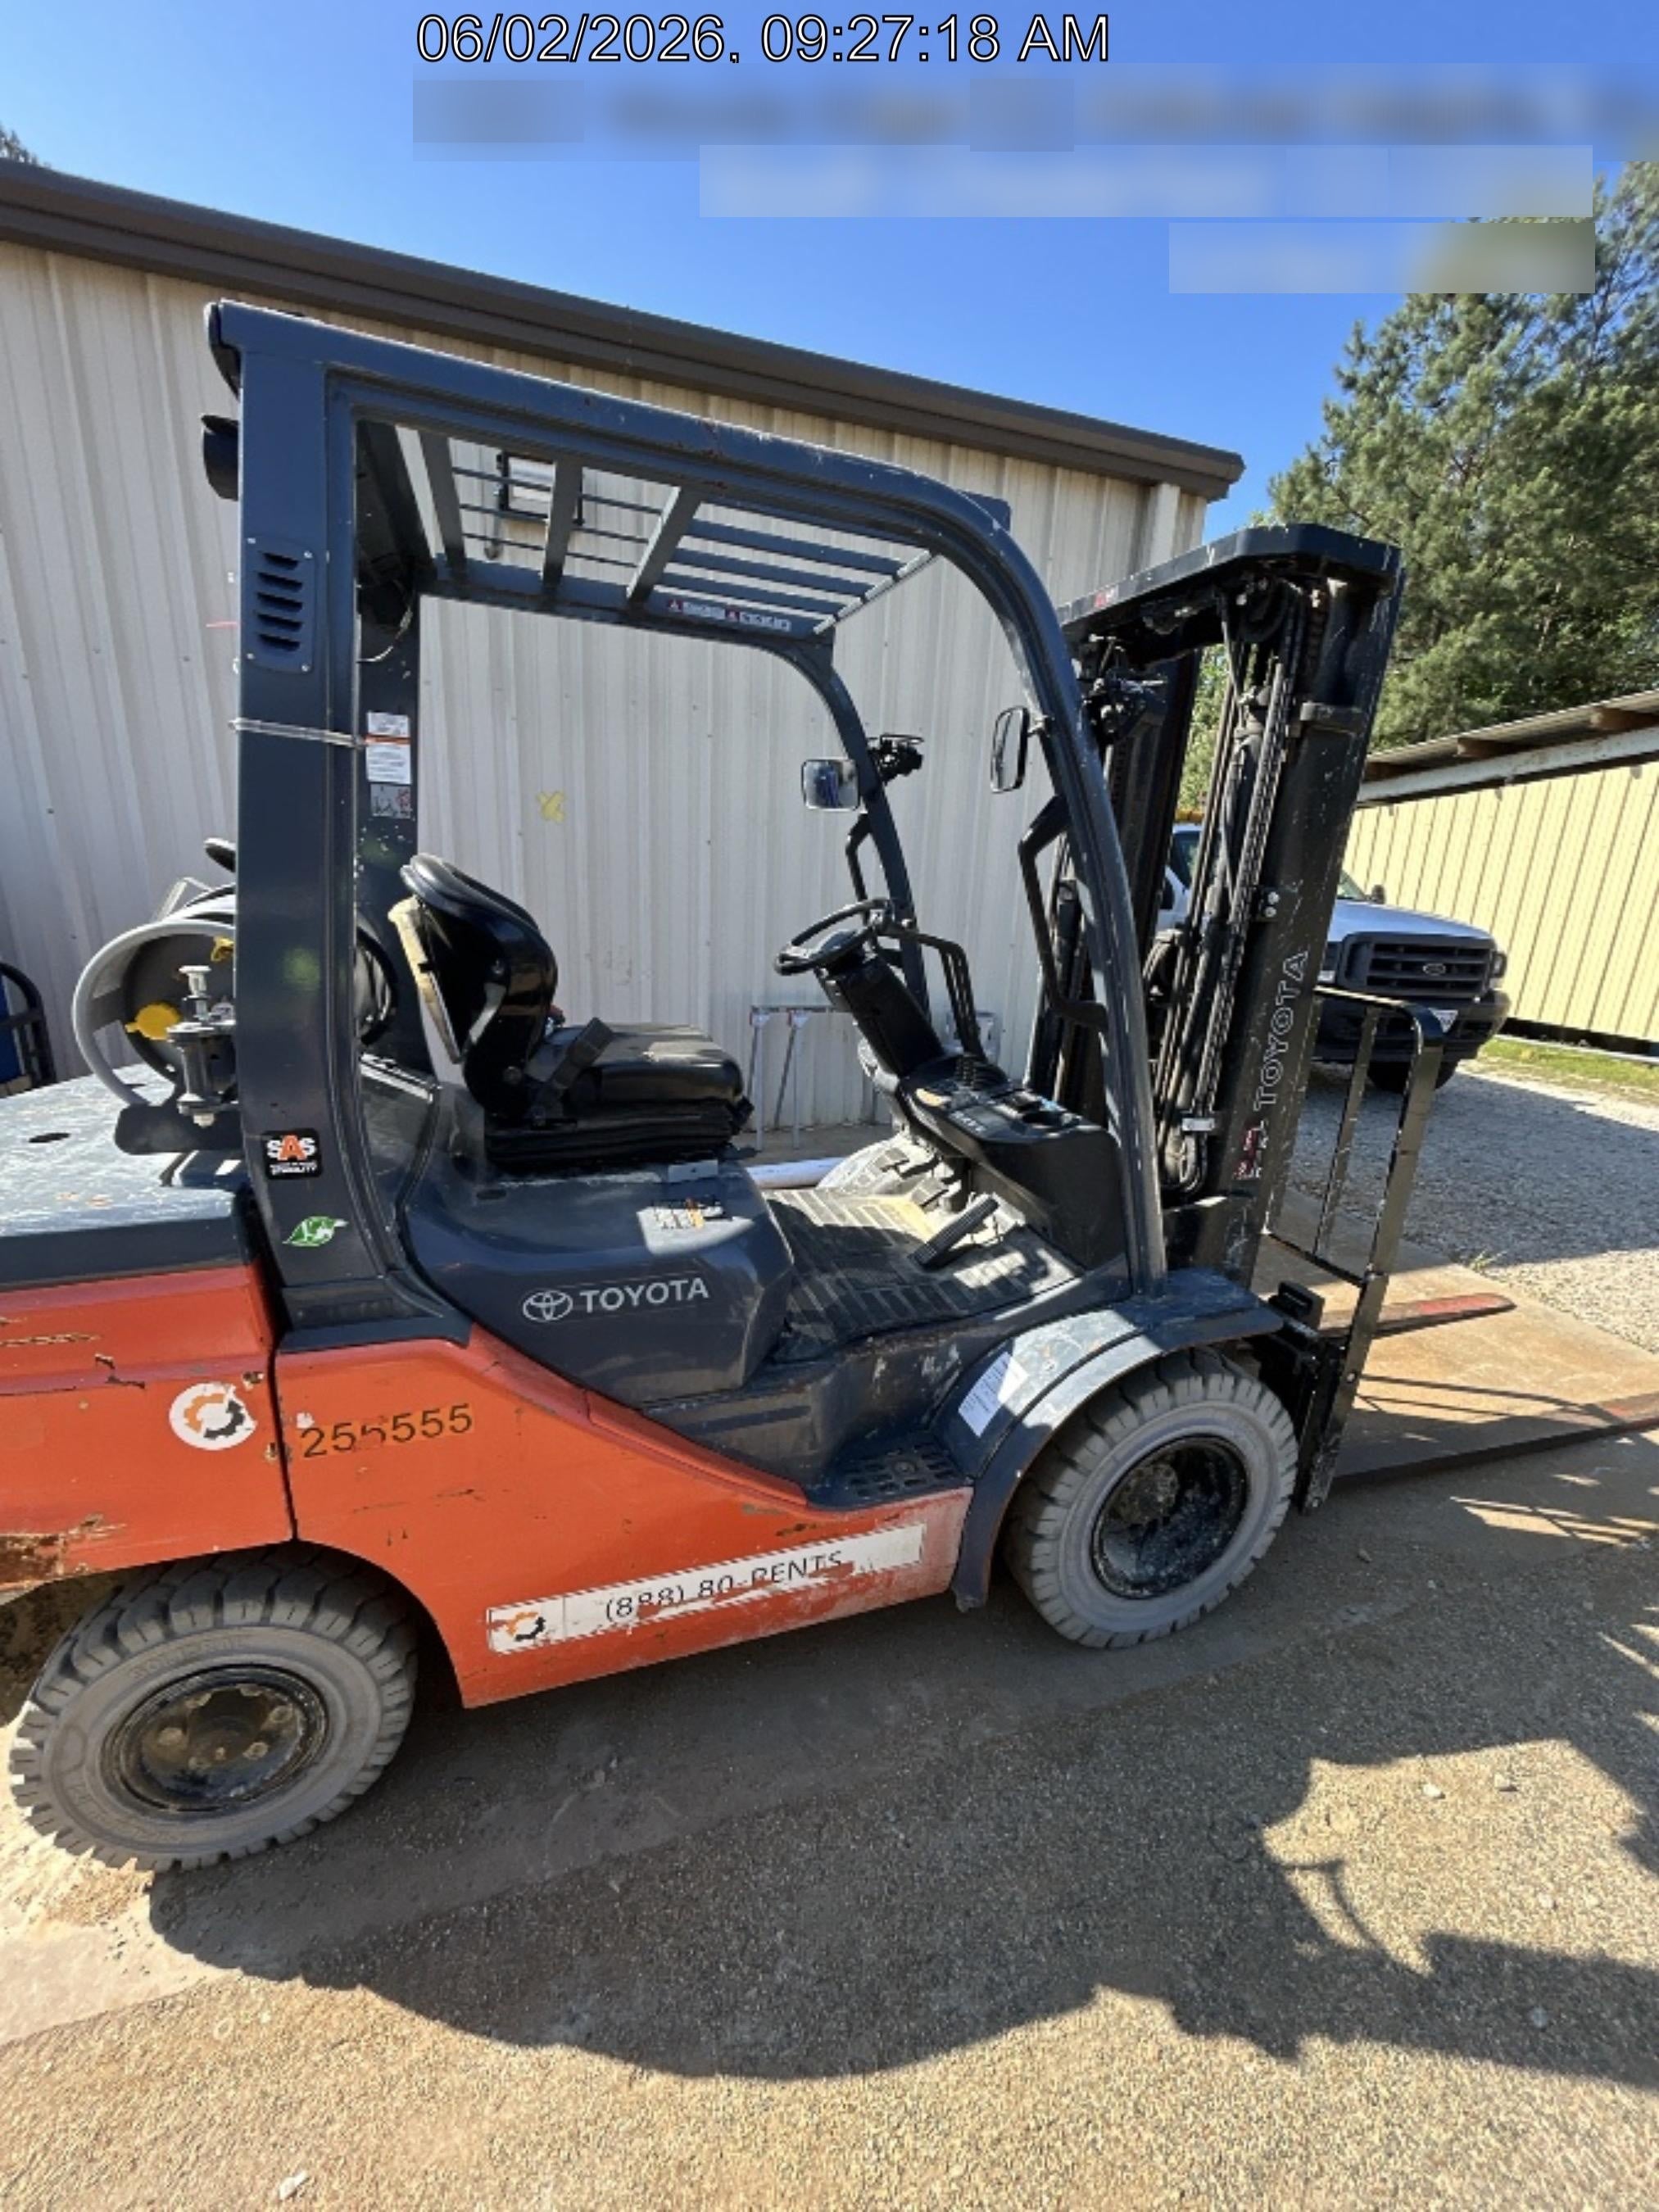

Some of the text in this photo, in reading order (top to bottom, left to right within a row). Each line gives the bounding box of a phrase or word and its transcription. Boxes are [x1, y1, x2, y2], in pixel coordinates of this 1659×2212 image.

[1253, 950, 1308, 1111] TOYOTA
[266, 1135, 316, 1161] SAS
[579, 1277, 709, 1313] TOYOTA
